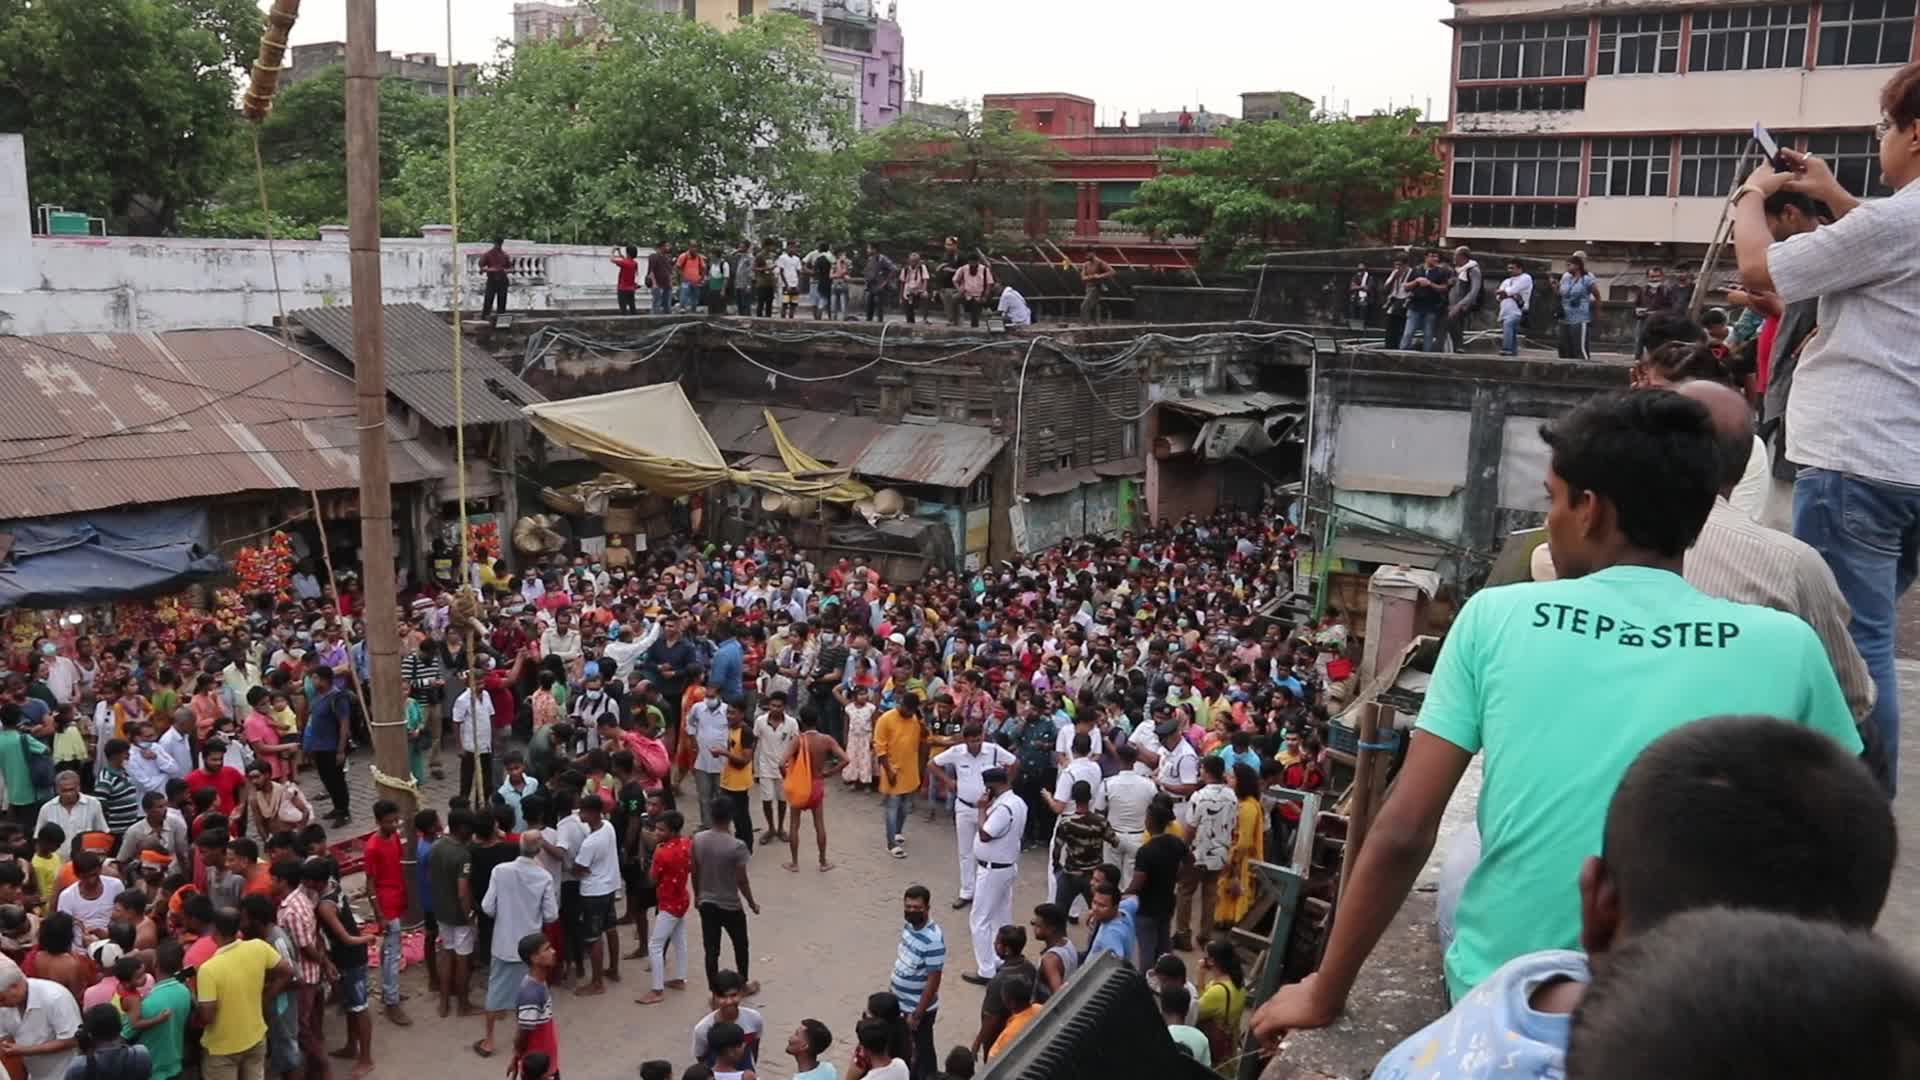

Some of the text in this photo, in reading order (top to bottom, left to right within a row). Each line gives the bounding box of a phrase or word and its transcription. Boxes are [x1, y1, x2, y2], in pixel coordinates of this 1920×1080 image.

[1532, 602, 1740, 648] STEP BY STEP
